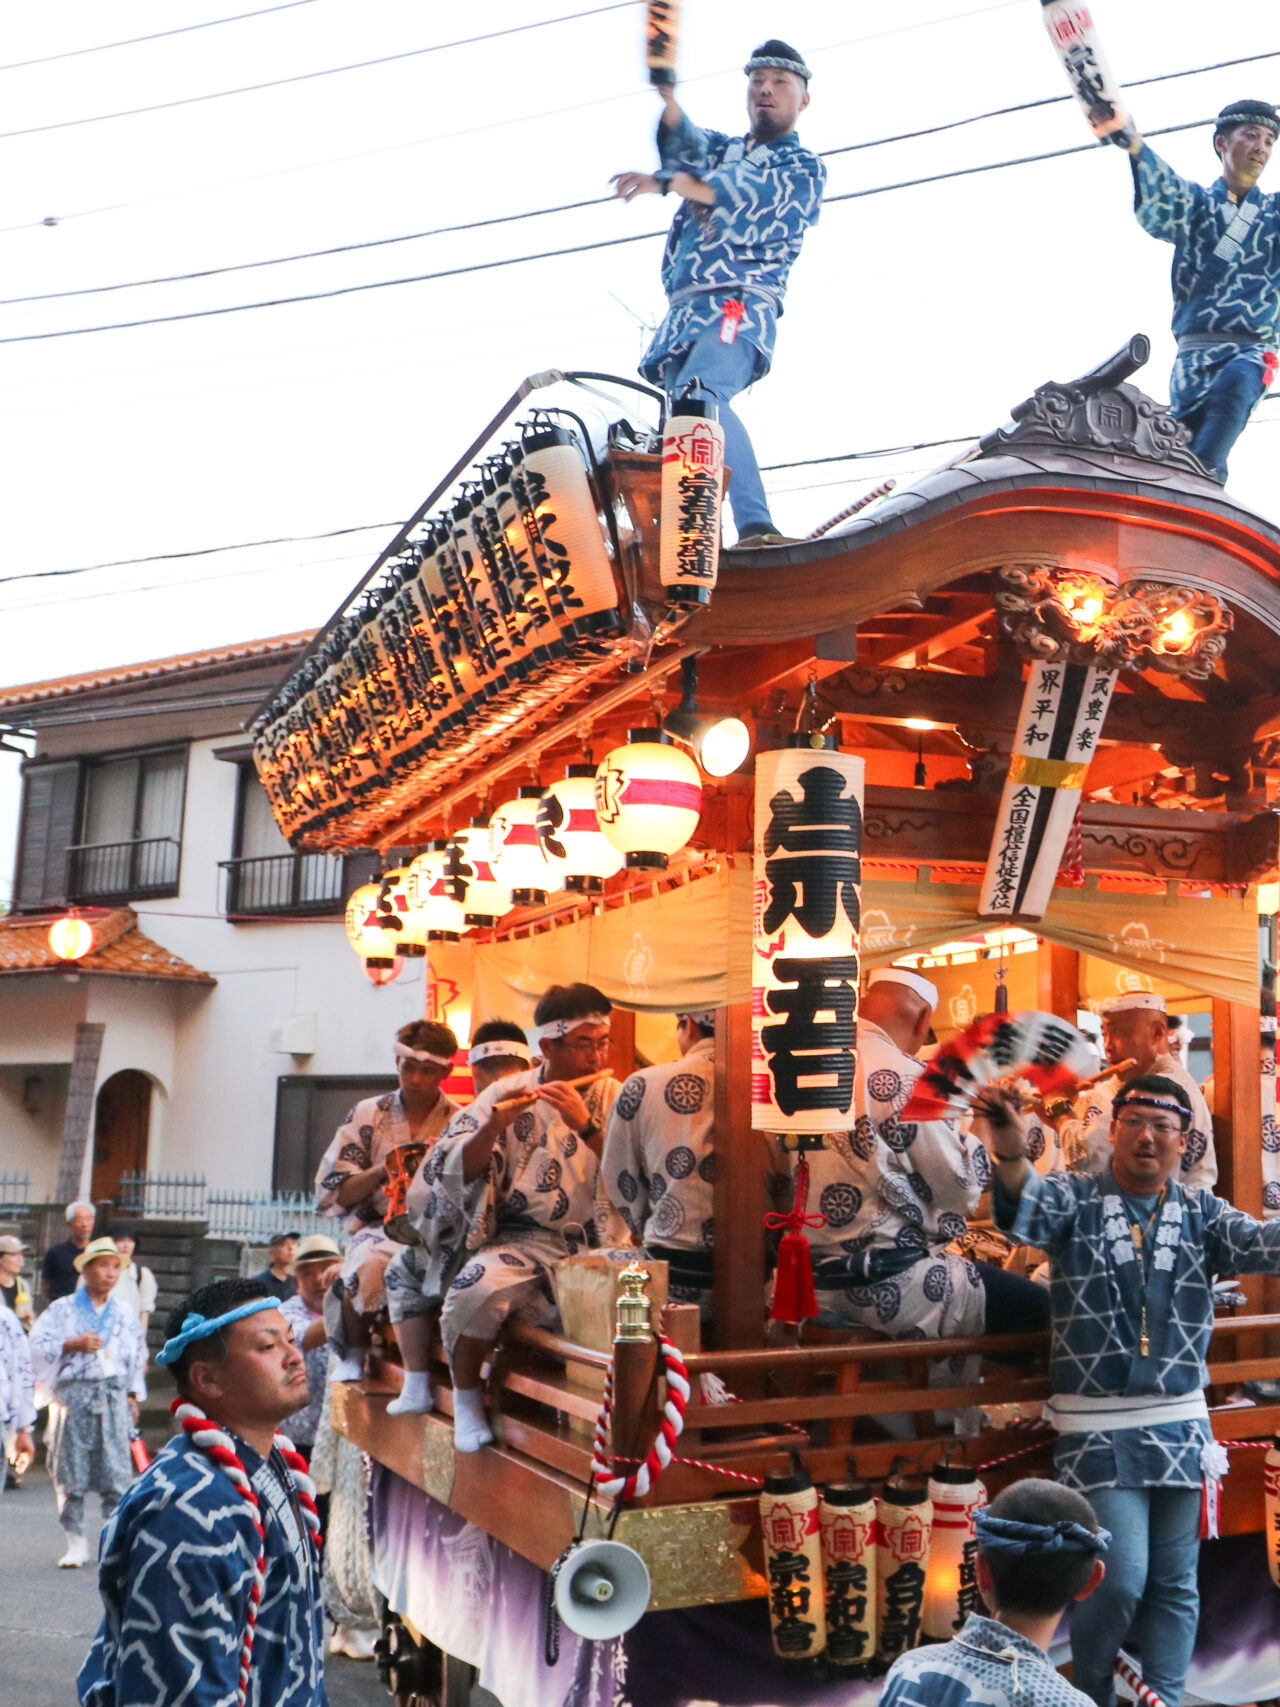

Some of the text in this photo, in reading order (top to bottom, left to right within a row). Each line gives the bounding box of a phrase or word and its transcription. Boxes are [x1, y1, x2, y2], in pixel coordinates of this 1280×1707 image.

[1023, 659, 1061, 746] 界平和
[988, 786, 1037, 912] 全国檀信徒各位
[761, 766, 863, 1117] 宗吾
